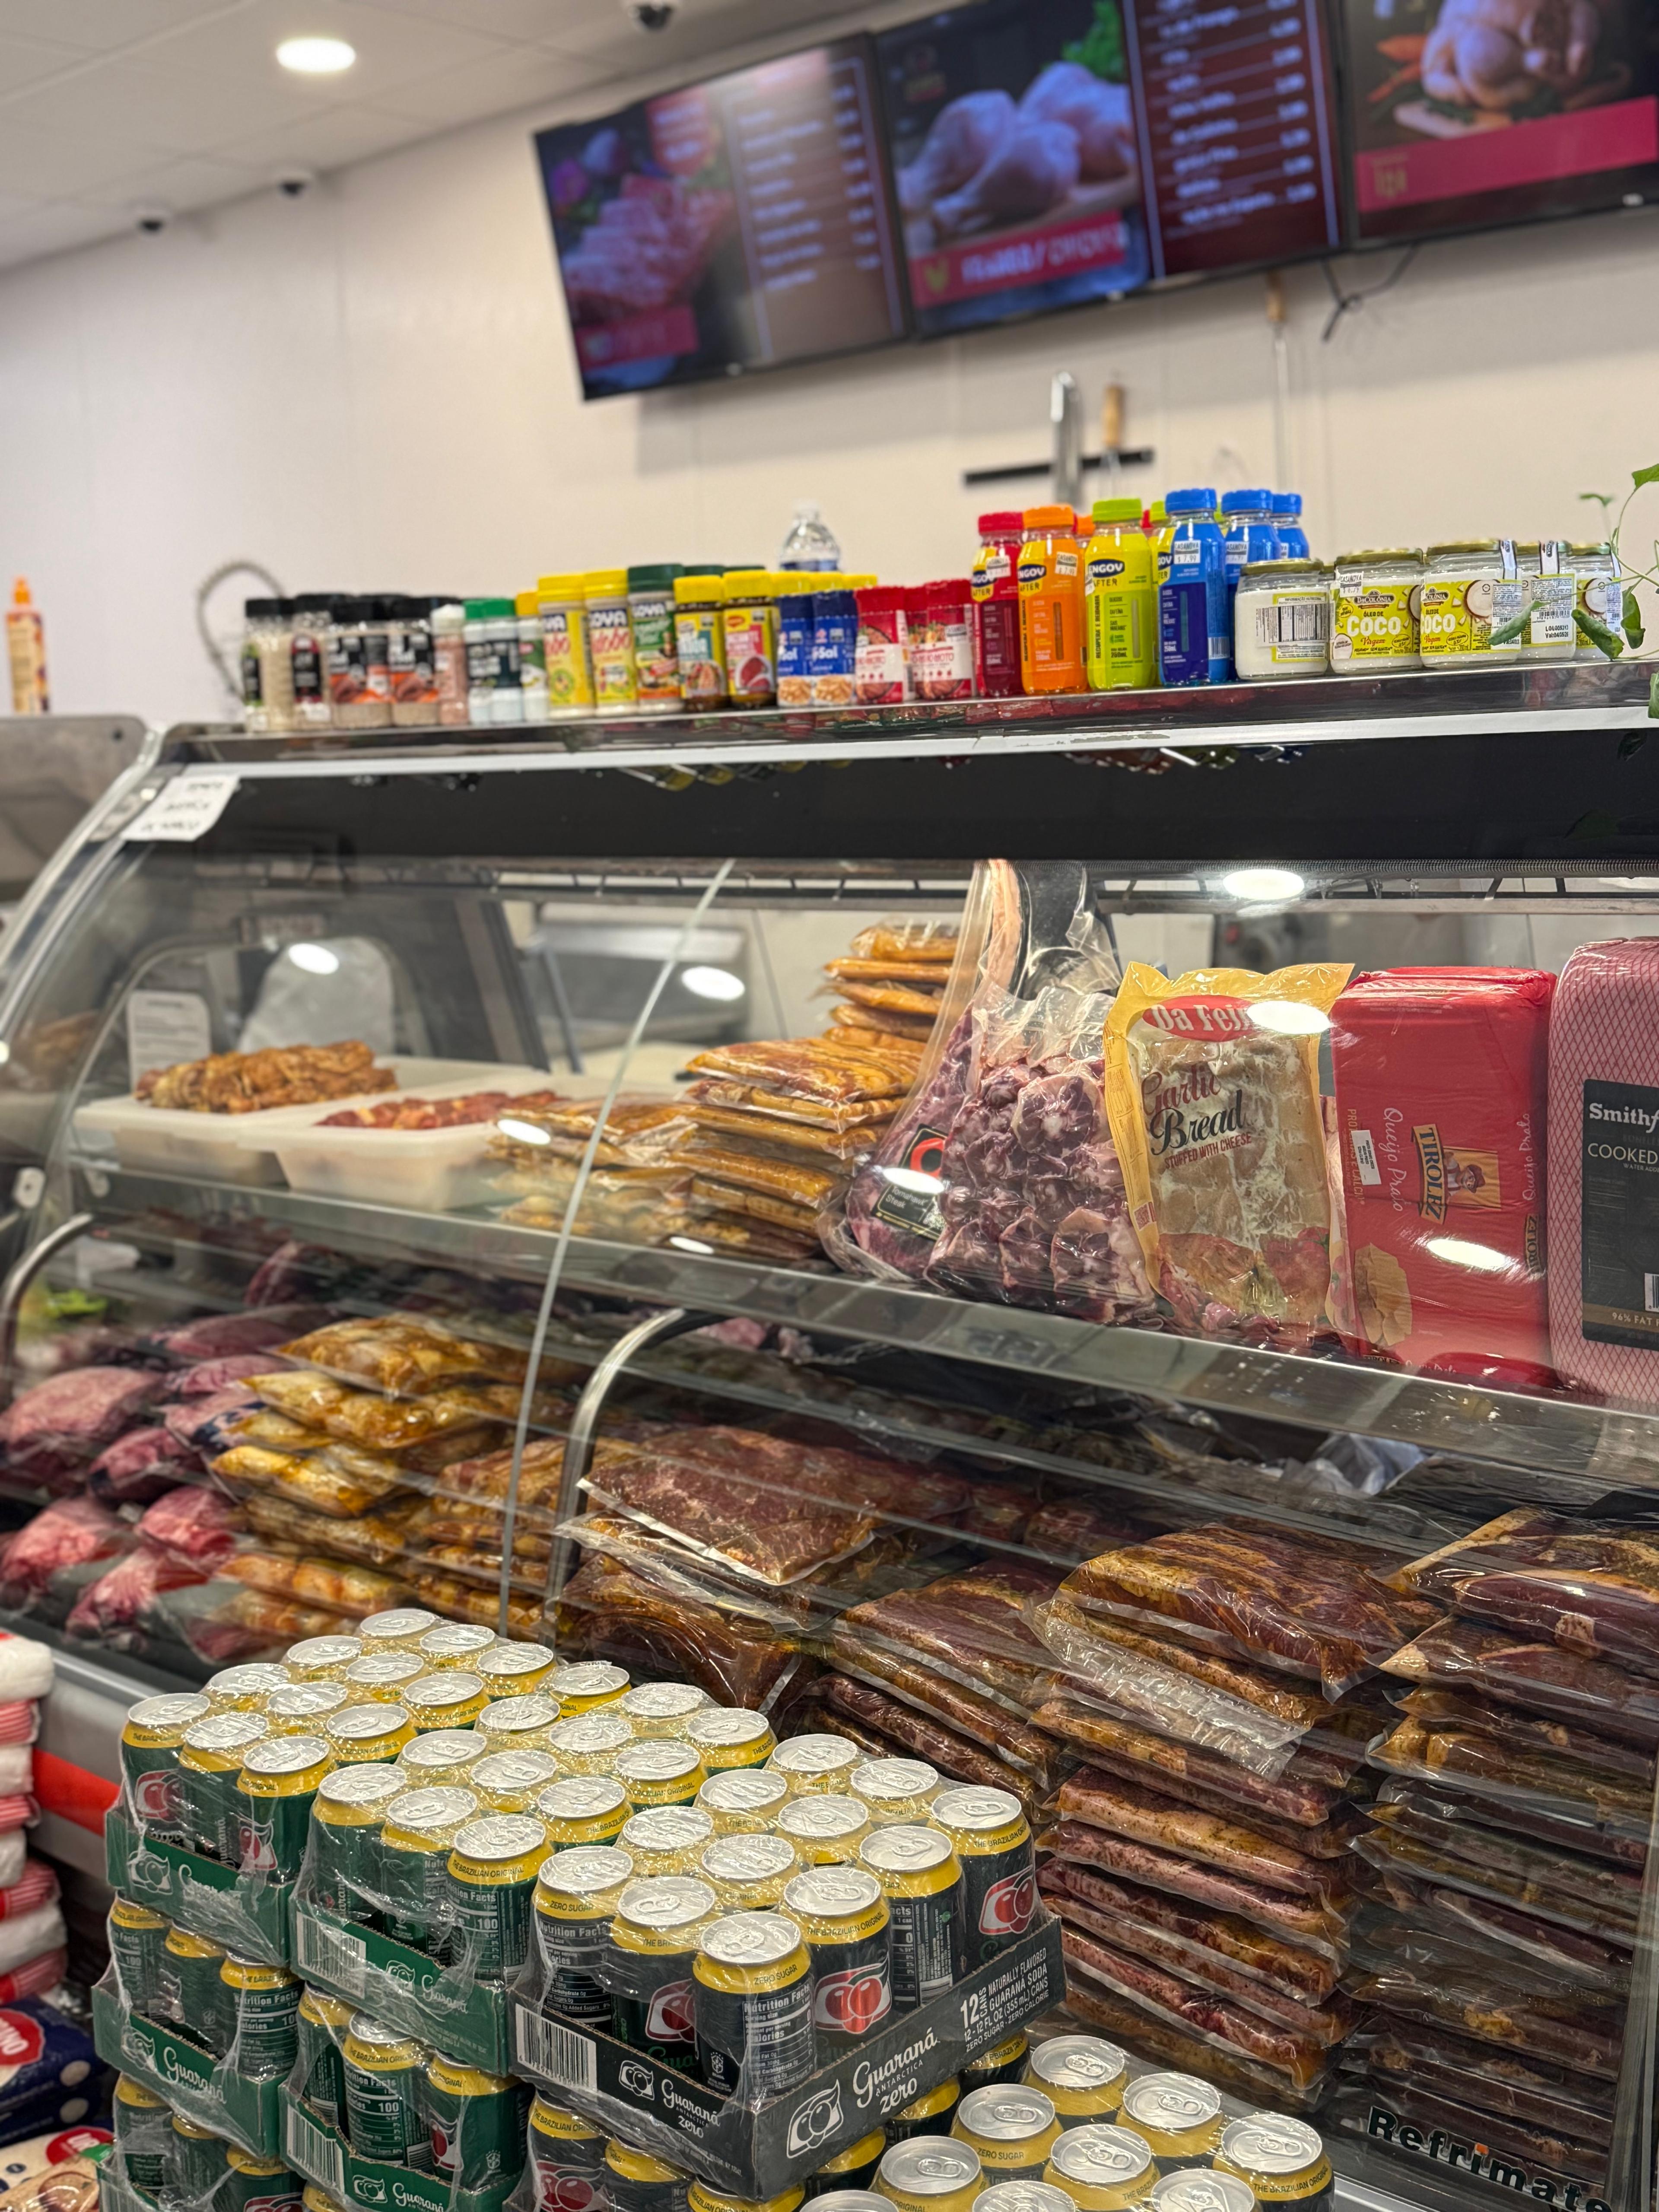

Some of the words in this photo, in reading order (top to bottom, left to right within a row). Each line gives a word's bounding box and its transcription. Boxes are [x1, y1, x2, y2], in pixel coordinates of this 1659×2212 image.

[1175, 541, 1199, 550] CASANOVA
[1347, 616, 1401, 637] COCO
[1151, 1004, 1193, 1031] Da
[1141, 1065, 1222, 1116] Garlic
[1150, 1090, 1247, 1156] Bread
[1378, 1107, 1403, 1162] Queijo
[1165, 1149, 1198, 1169] STUFFED
[1199, 1144, 1219, 1159] WITH
[1220, 1133, 1252, 1152] CHEESE
[1588, 1143, 1658, 1165] COOKED
[1419, 1127, 1442, 1220] TIROLEZ
[1623, 1163, 1644, 1171] WATER
[891, 1186, 928, 1206] Tomahawk
[1387, 1167, 1408, 1212] Prato
[885, 1195, 906, 1209] Steak
[1612, 1312, 1631, 1322] 96%
[1634, 1315, 1652, 1326] FAT
[559, 1703, 578, 1711] IGINAL
[459, 1864, 489, 1877] BRAZILIAN
[470, 1890, 496, 1902] Facts
[550, 1900, 567, 1911] ZERO
[568, 1904, 593, 1913] SUGAR
[891, 1906, 912, 1916] acts
[477, 1918, 498, 1930] 100
[578, 1926, 607, 1937] Facts
[807, 1926, 821, 1936] THE
[821, 1924, 860, 1936] BRAZILIAN
[861, 1911, 884, 1931] ORIGINAL
[906, 1932, 913, 1944] 0
[548, 1953, 571, 1965] lories
[754, 1974, 775, 1986] ZERO
[775, 1964, 798, 1981] SUGAR
[988, 1966, 1019, 1996] NATURALLY
[1020, 1947, 1046, 1976] FLAVORED
[989, 1975, 1026, 2011] GUARANÁ
[1027, 1963, 1047, 1985] SODA
[960, 1993, 980, 2029] 12
[964, 2029, 972, 2043] 12
[976, 2021, 984, 2034] 12
[984, 2016, 993, 2029] FL
[993, 2007, 1003, 2021] OZ
[1004, 2000, 1018, 2017] (355
[1019, 1989, 1030, 2004] mL)
[1030, 1977, 1048, 1996] CANS
[979, 1987, 987, 2018] CANS
[966, 2035, 983, 2053] ZERO
[984, 2021, 1004, 2041] SUGAR
[1008, 2008, 1024, 2024] ZERO
[1024, 1989, 1049, 2011] CALORIE
[852, 2027, 938, 2108] Guaraná
[876, 2059, 923, 2097] ANTARCTICA
[378, 2102, 399, 2113] 100
[661, 2079, 721, 2127] Guaraná
[880, 2078, 917, 2115] zero
[540, 2115, 571, 2131] BRAZILIAN
[678, 2115, 704, 2138] zero
[977, 2148, 997, 2159] ZERO
[998, 2151, 1024, 2160] SUGAR
[1122, 2189, 1136, 2200] THE
[1253, 2183, 1268, 2193] THE
[1269, 2182, 1309, 2193] BRAZILIAN
